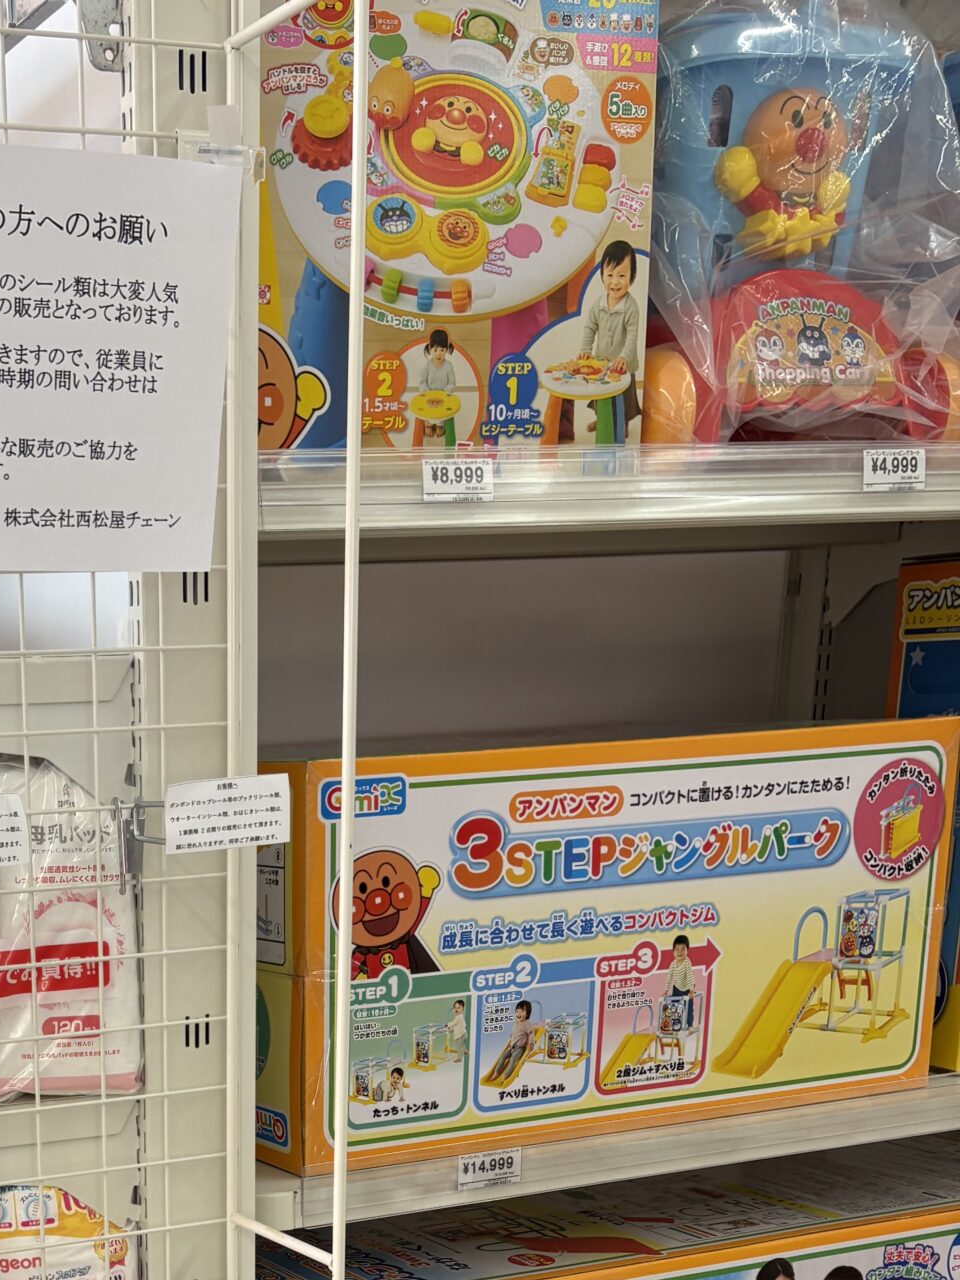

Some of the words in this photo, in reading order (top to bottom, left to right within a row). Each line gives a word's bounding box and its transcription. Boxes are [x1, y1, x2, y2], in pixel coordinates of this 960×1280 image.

[611, 43, 632, 66] 12
[616, 82, 640, 90] メロディ
[609, 93, 646, 116] 5曲入り
[759, 298, 850, 322] ANPANMAN
[371, 360, 399, 369] STEP
[498, 363, 531, 374] STEP
[377, 372, 392, 396] 2
[506, 377, 518, 405] 1
[363, 417, 405, 429] テーブル
[482, 424, 542, 435] ビジーテーブル
[431, 467, 484, 484] ¥8,999
[872, 457, 918, 474] ¥4,999
[4, 507, 182, 529] 株式会社西松屋チェーン
[630, 776, 851, 808] コンパクトに置ける!カンタンにたためる!
[867, 765, 936, 802] カンタン折りたたみ
[518, 794, 617, 818] アンパンマン
[453, 815, 842, 891] 3STEPジャングルパーク
[864, 847, 928, 878] コンパクト収納!
[441, 905, 716, 951] 成長に合わせて長く遊べるコンパクトジム
[600, 949, 653, 973] STEP3
[476, 962, 531, 987] STEP2
[484, 1015, 513, 1024] できるように
[616, 1062, 684, 1078] 2段ジム+すべり台
[498, 1086, 565, 1101] すべり台+トンネル
[372, 1102, 439, 1118] たっち・トンネル
[463, 1156, 514, 1175] ¥14,999
